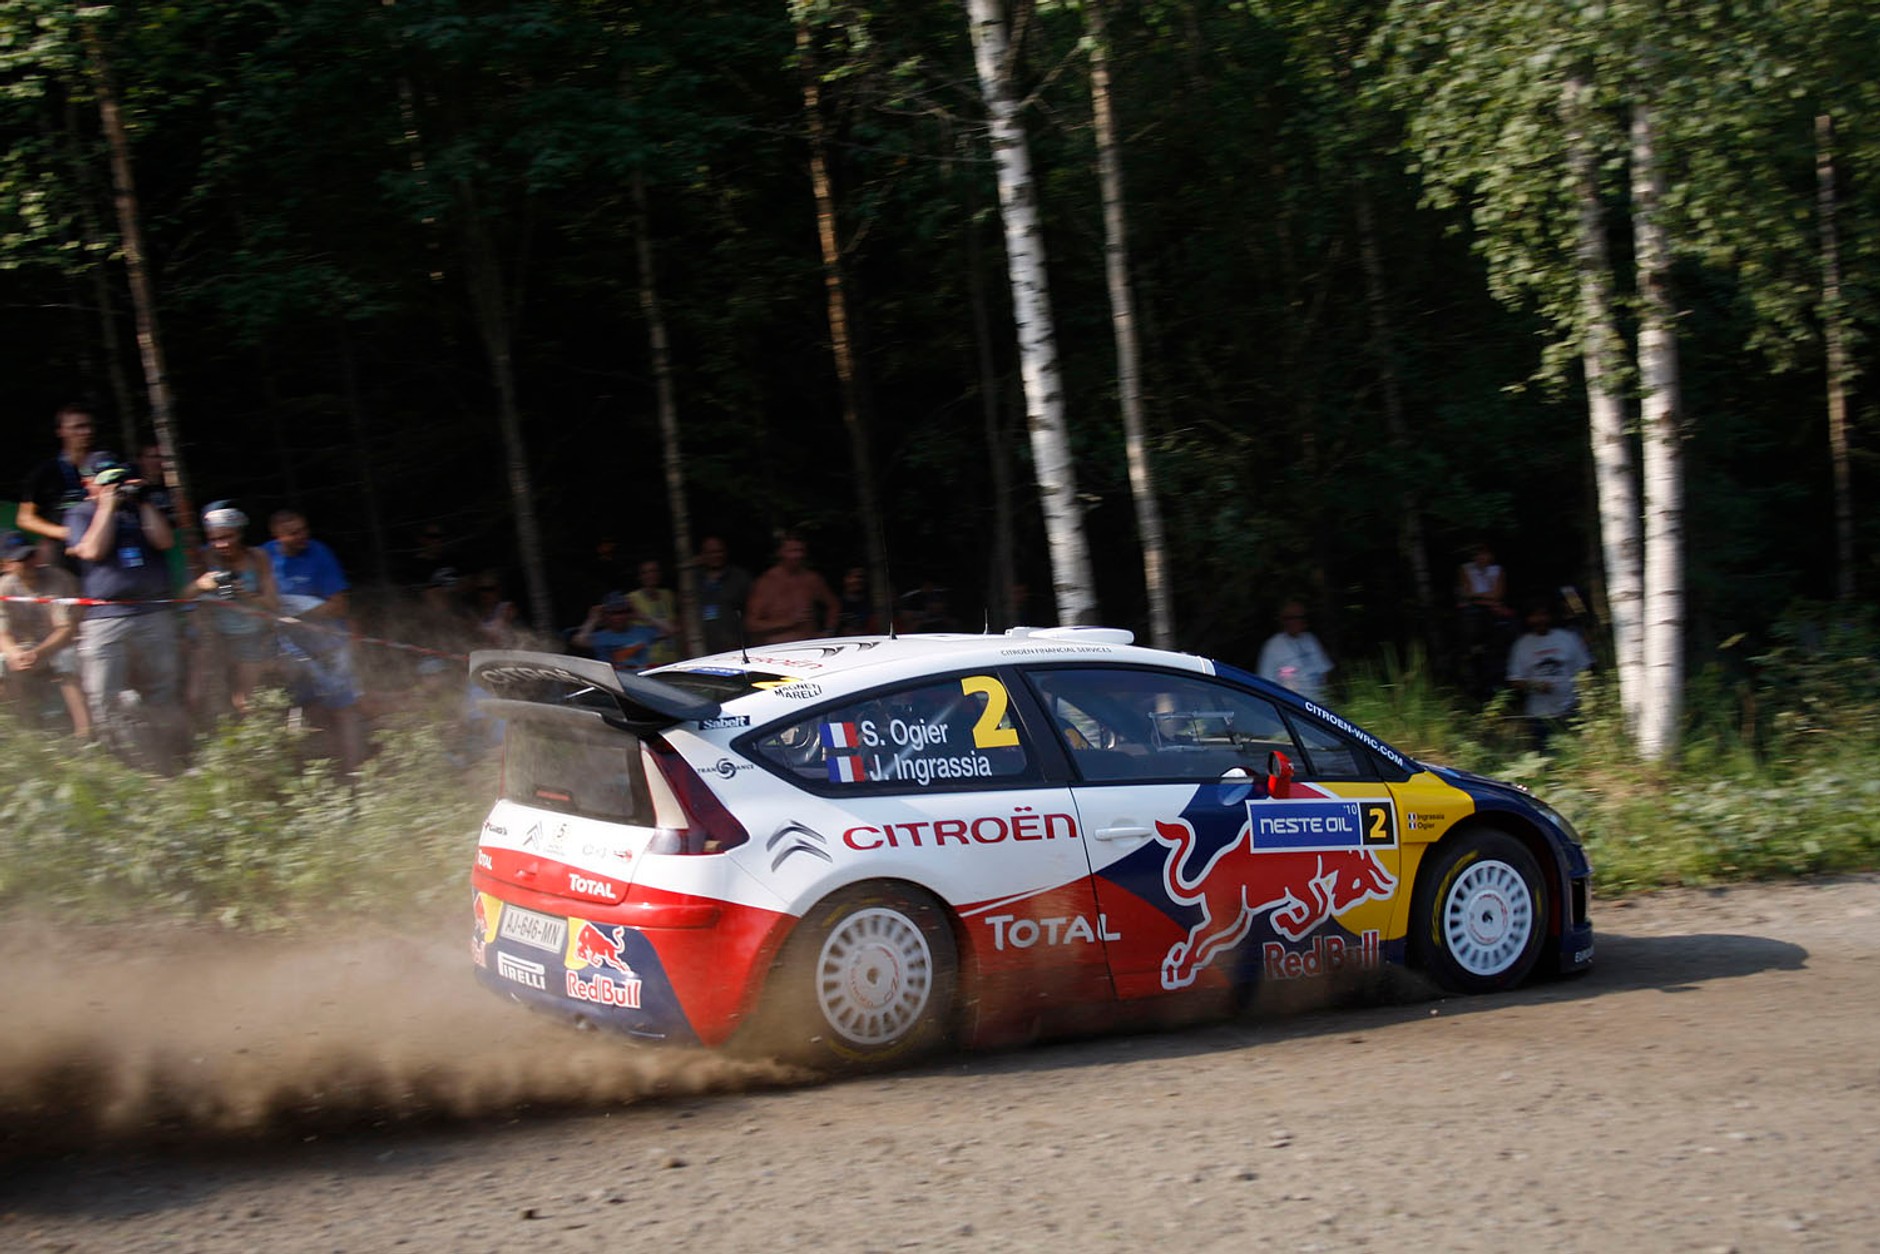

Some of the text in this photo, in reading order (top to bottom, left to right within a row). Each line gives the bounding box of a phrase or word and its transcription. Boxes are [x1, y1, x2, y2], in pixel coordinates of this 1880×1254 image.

[703, 716, 746, 729] Sabelt
[961, 675, 1020, 749] 2
[863, 718, 949, 751] S. Ogier
[1304, 701, 1404, 767] CITROEN-WRC.COM
[869, 750, 993, 786] J. Ingrassia
[842, 806, 1078, 851] CITROËN
[1326, 816, 1353, 832] OIL
[1368, 808, 1388, 839] 2
[568, 873, 617, 899] TOTAL
[505, 913, 561, 946] AJ-646-MN
[984, 913, 1121, 951] TOTAL
[497, 951, 547, 990] PIRELLI
[1263, 936, 1323, 980] Red
[566, 970, 642, 1009] Red Bull
